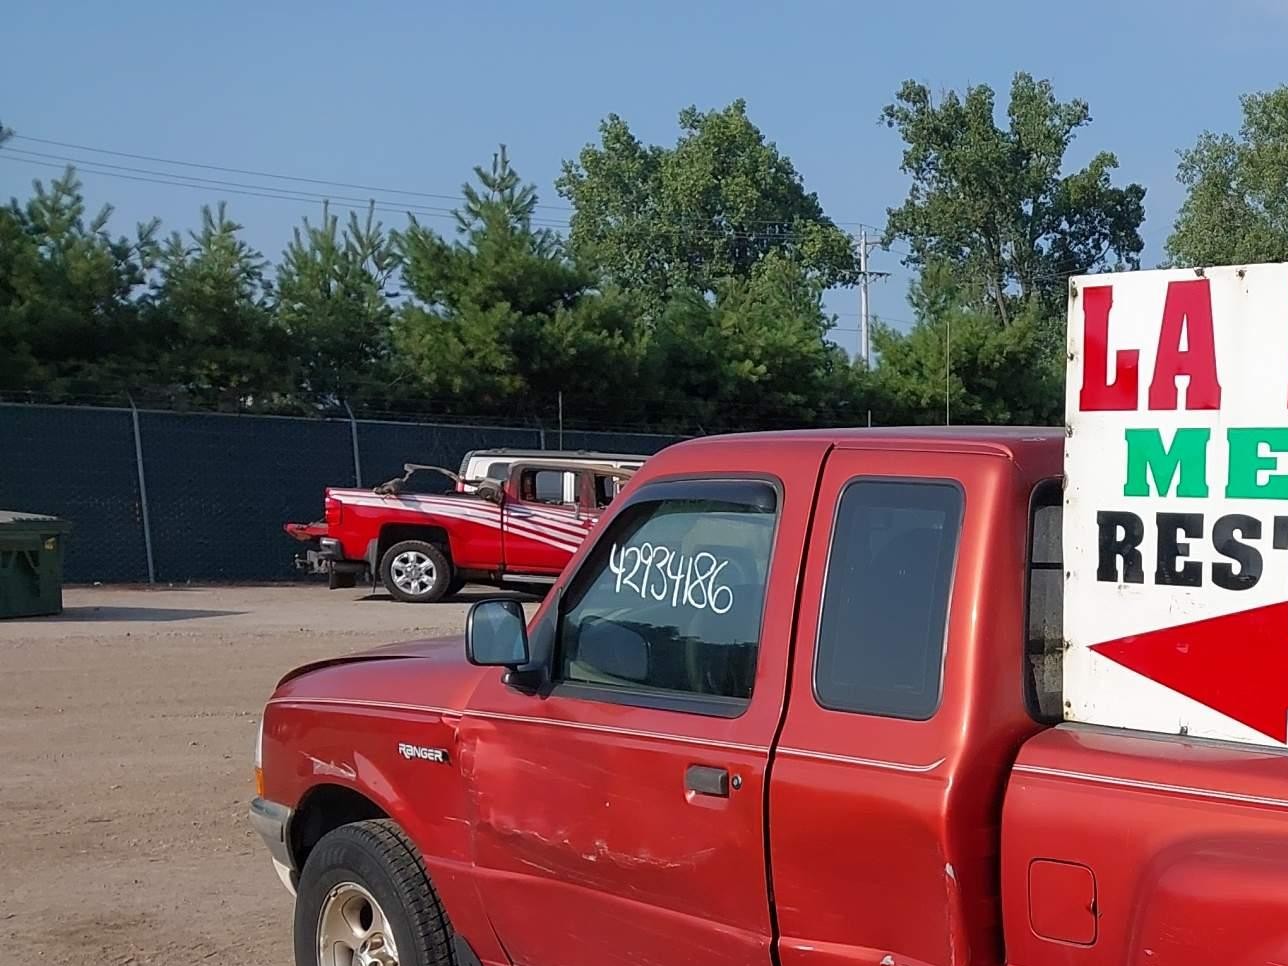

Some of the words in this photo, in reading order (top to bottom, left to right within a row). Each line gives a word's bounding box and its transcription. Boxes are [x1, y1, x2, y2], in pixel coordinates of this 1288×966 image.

[1079, 278, 1222, 412] LA
[609, 542, 734, 614] 42934186
[398, 743, 444, 762] RANGER
